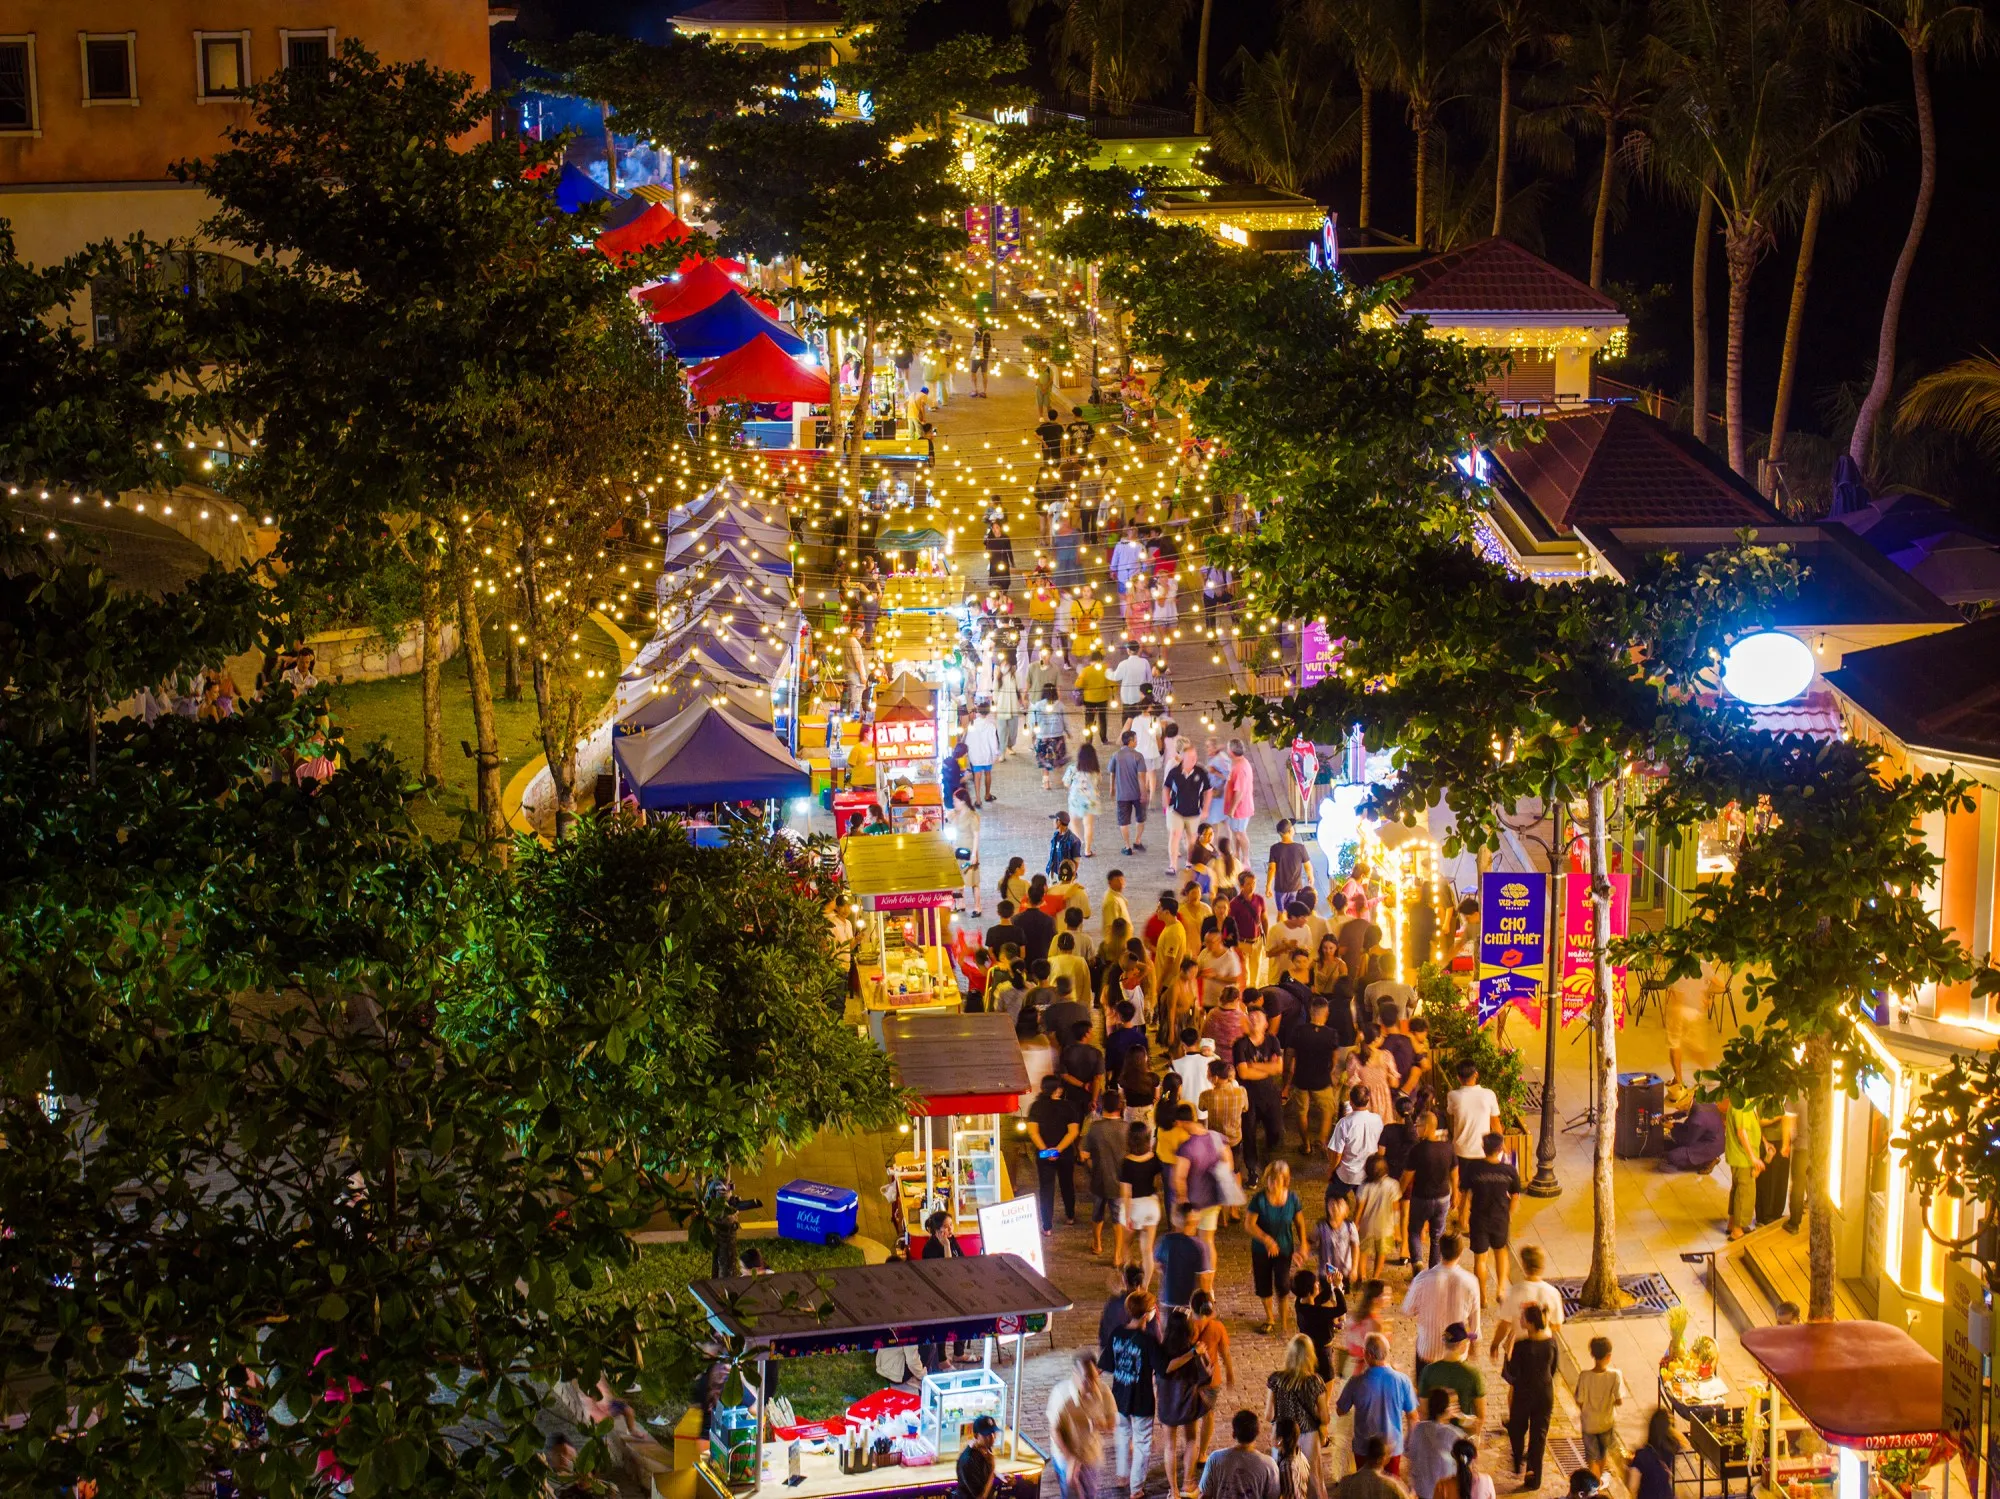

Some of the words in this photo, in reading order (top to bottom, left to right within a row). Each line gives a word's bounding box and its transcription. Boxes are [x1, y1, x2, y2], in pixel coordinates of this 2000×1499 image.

[1500, 917, 1526, 934] CHỢ
[796, 1210, 821, 1226] 1664
[796, 1222, 821, 1234] BLANC
